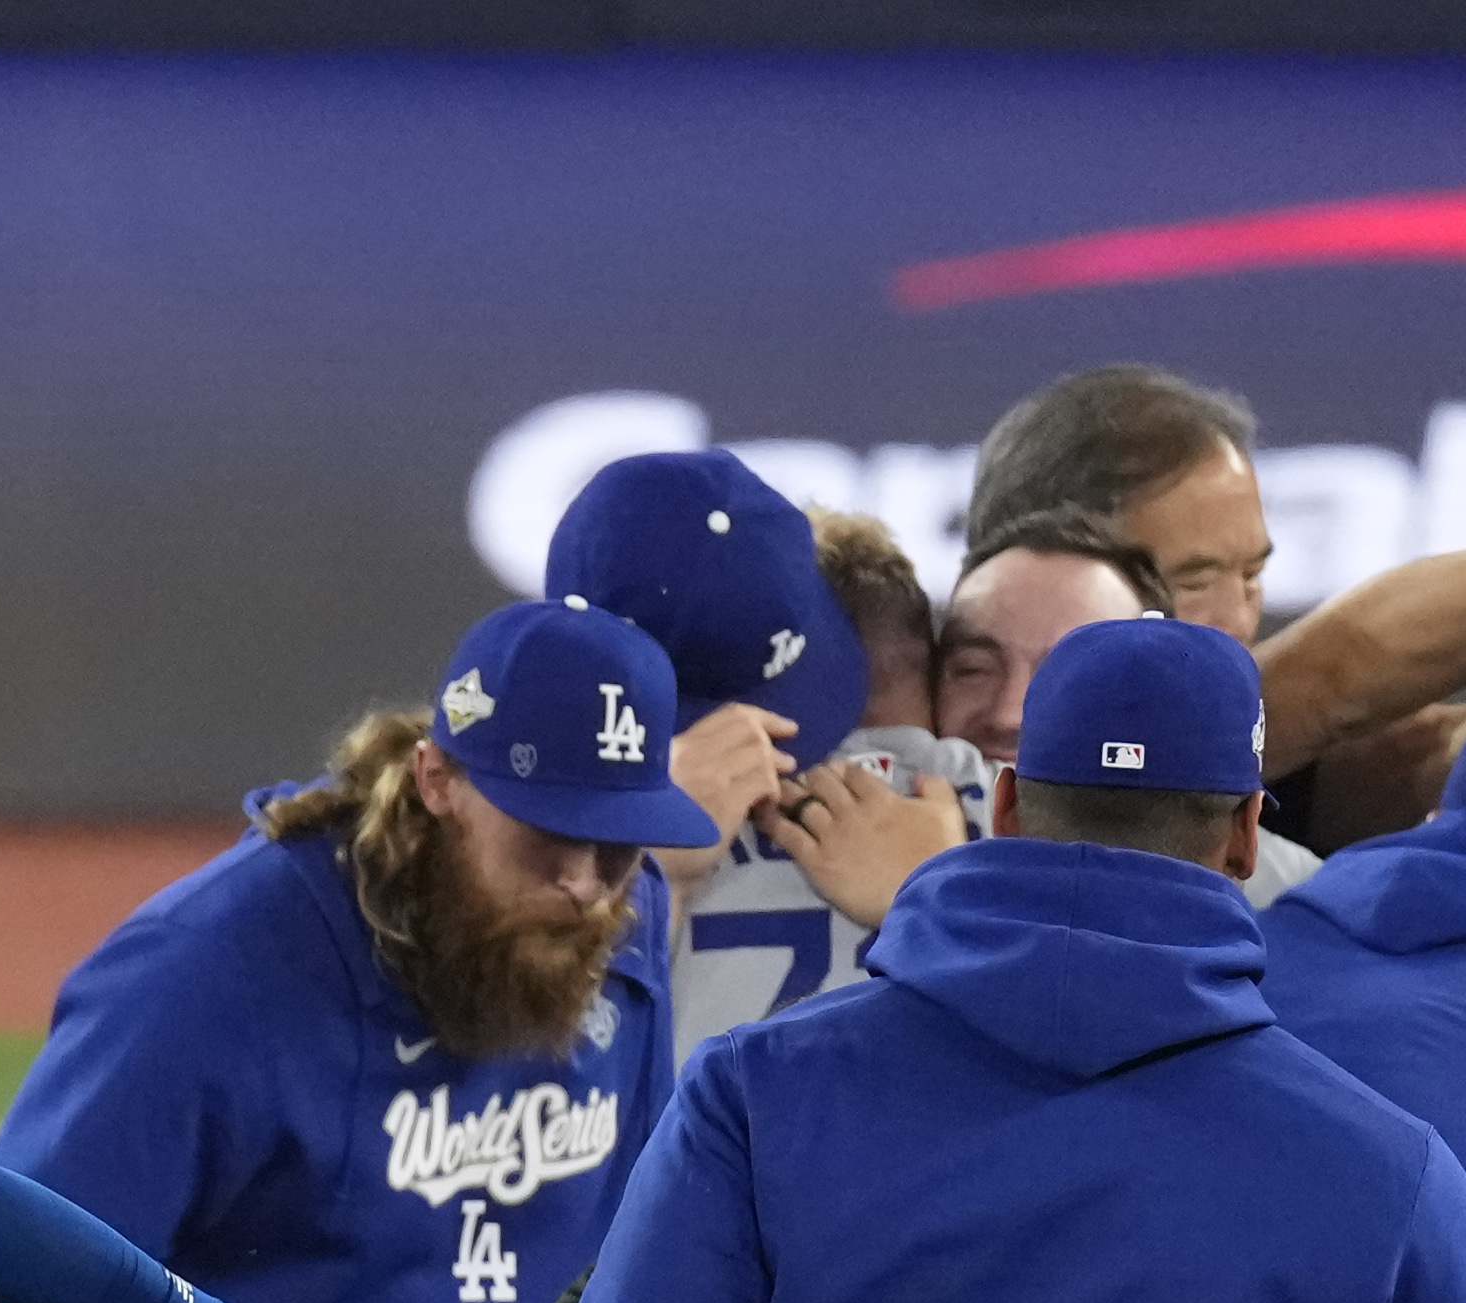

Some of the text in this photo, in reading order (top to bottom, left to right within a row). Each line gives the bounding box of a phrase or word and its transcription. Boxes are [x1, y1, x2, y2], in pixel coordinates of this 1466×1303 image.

[596, 683, 645, 763] LA
[692, 908, 886, 1018] 7
[452, 1200, 517, 1303] LA
